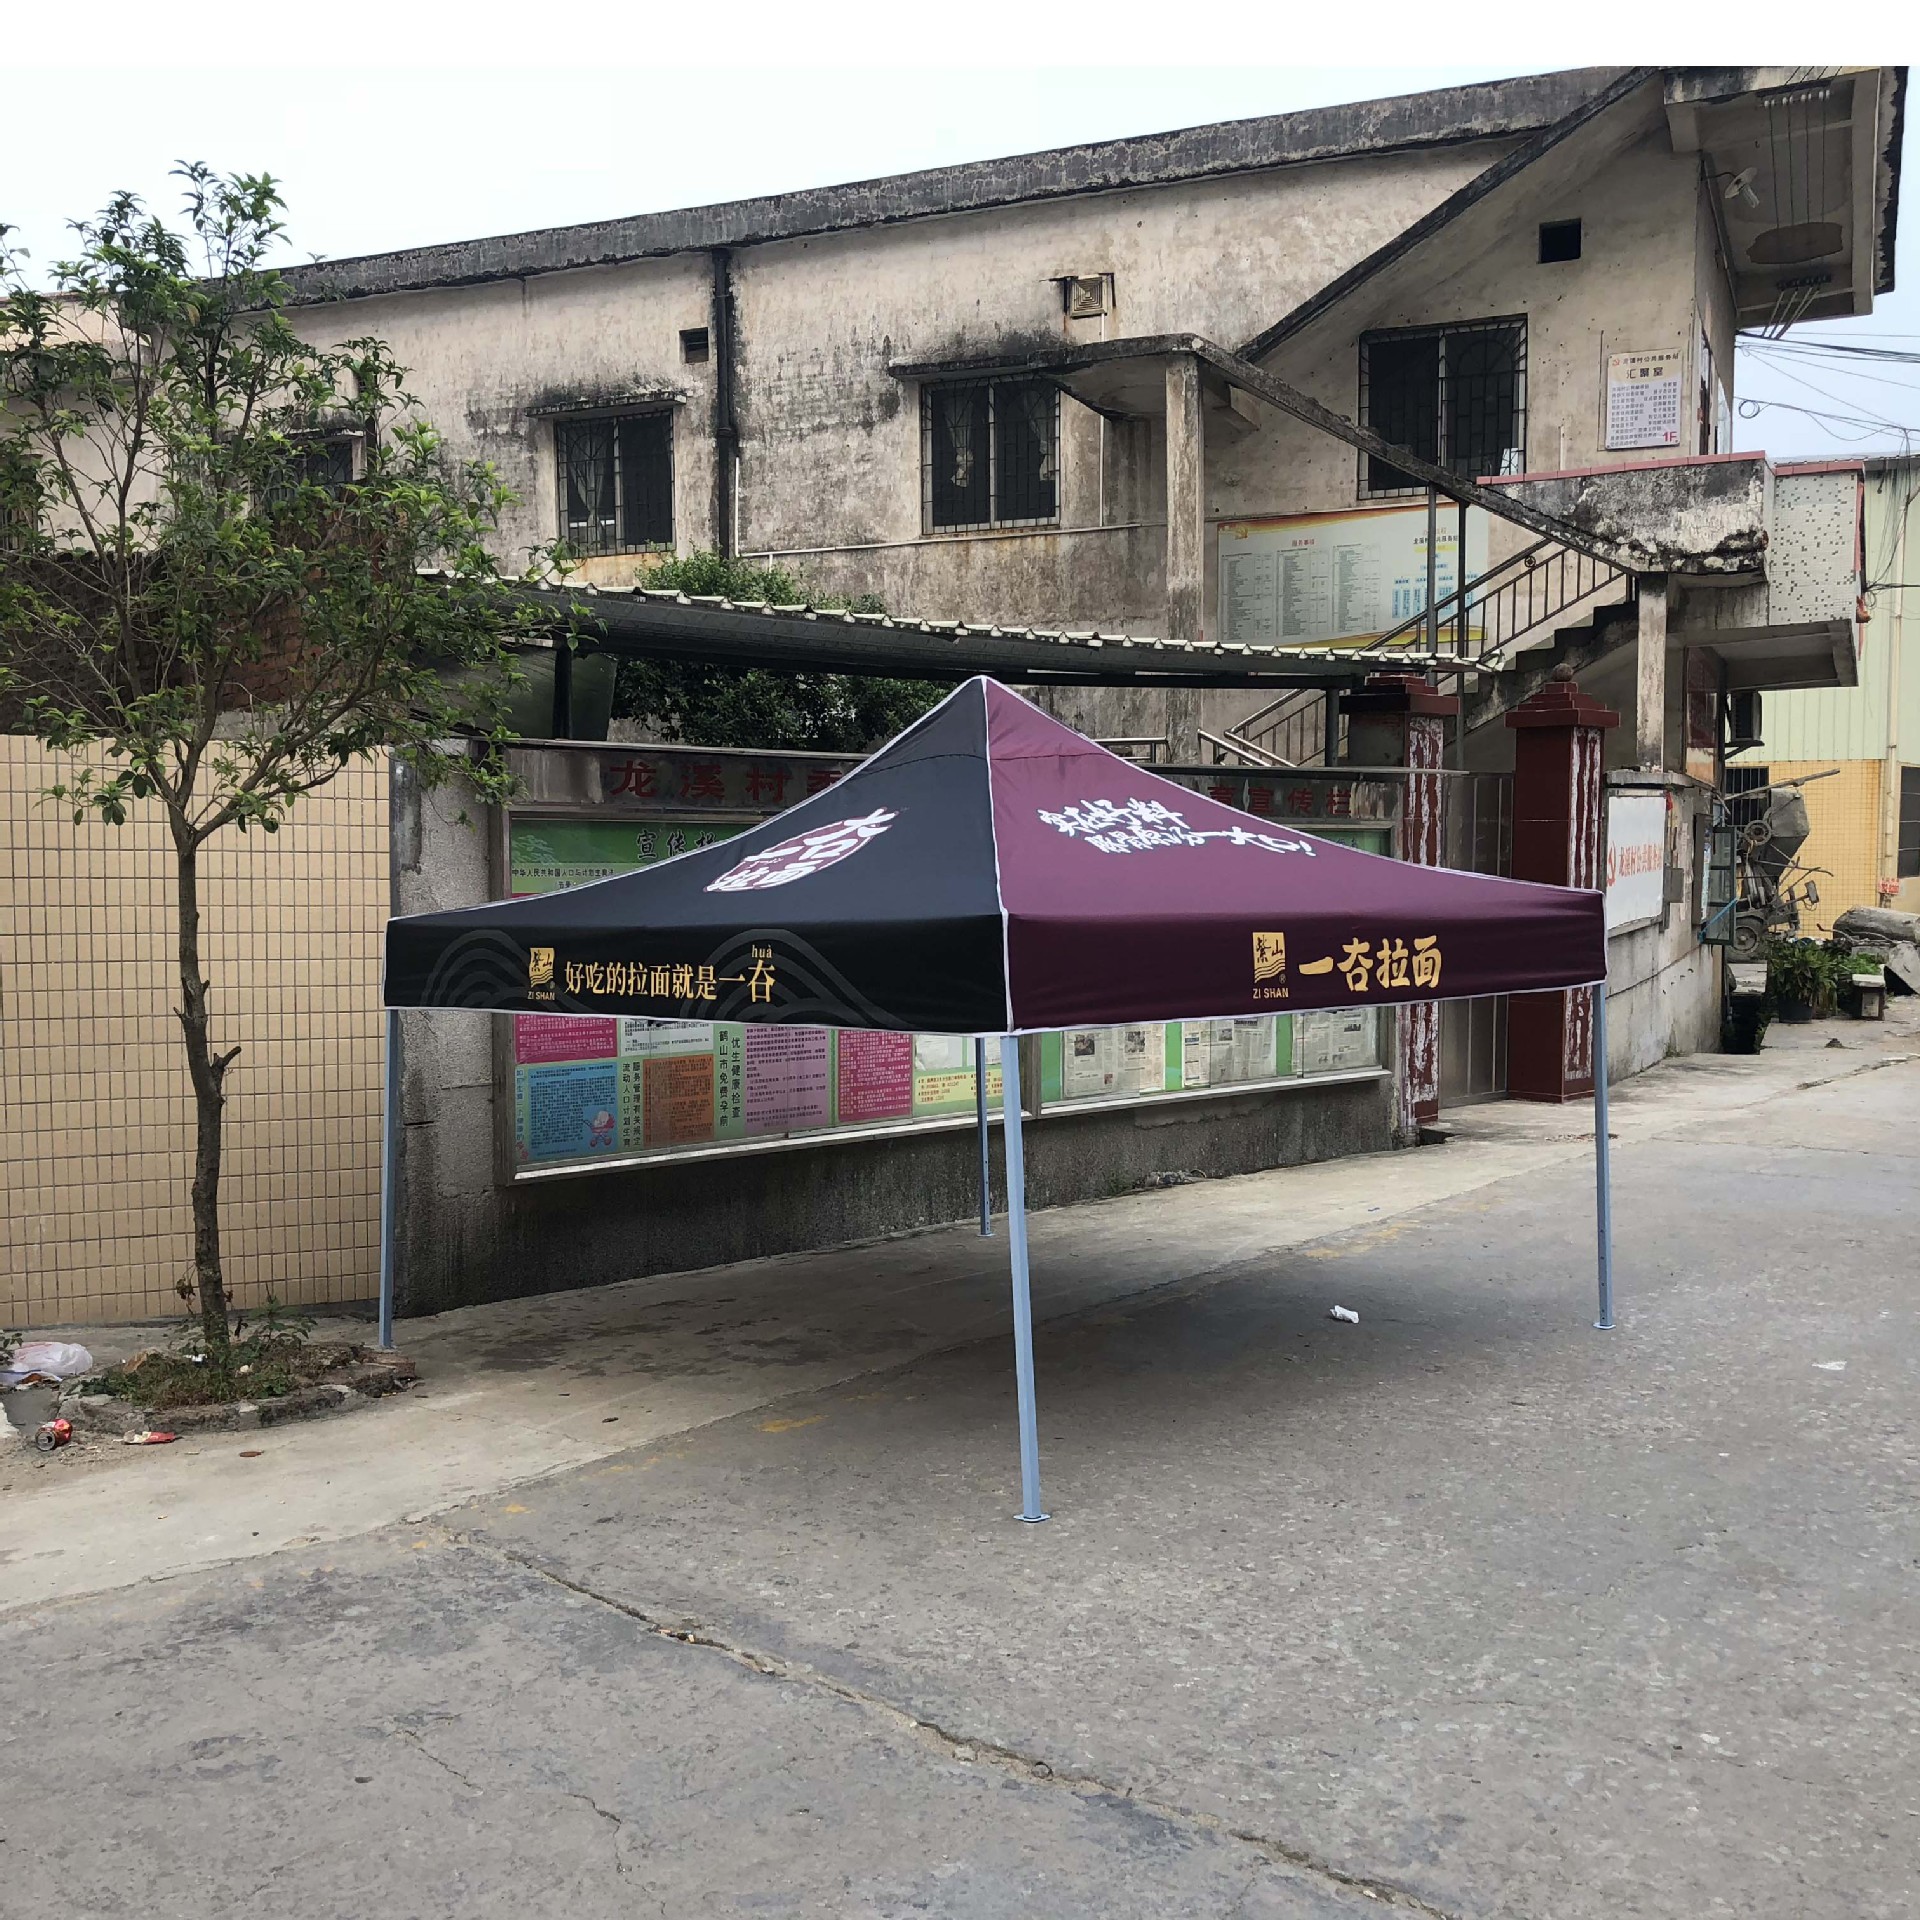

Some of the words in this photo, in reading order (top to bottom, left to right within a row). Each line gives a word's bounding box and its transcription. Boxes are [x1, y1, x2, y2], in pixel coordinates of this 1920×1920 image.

[1663, 431, 1677, 442] 1F
[527, 991, 535, 1000] ZI
[536, 991, 555, 1001] SHAN
[1253, 988, 1261, 999] ZI
[1264, 988, 1289, 999] SHAN
[719, 1030, 729, 1127] 鹤山市免费孕前
[731, 1037, 741, 1119] 优生健康检查
[622, 1062, 631, 1148] 流动人口计划生育
